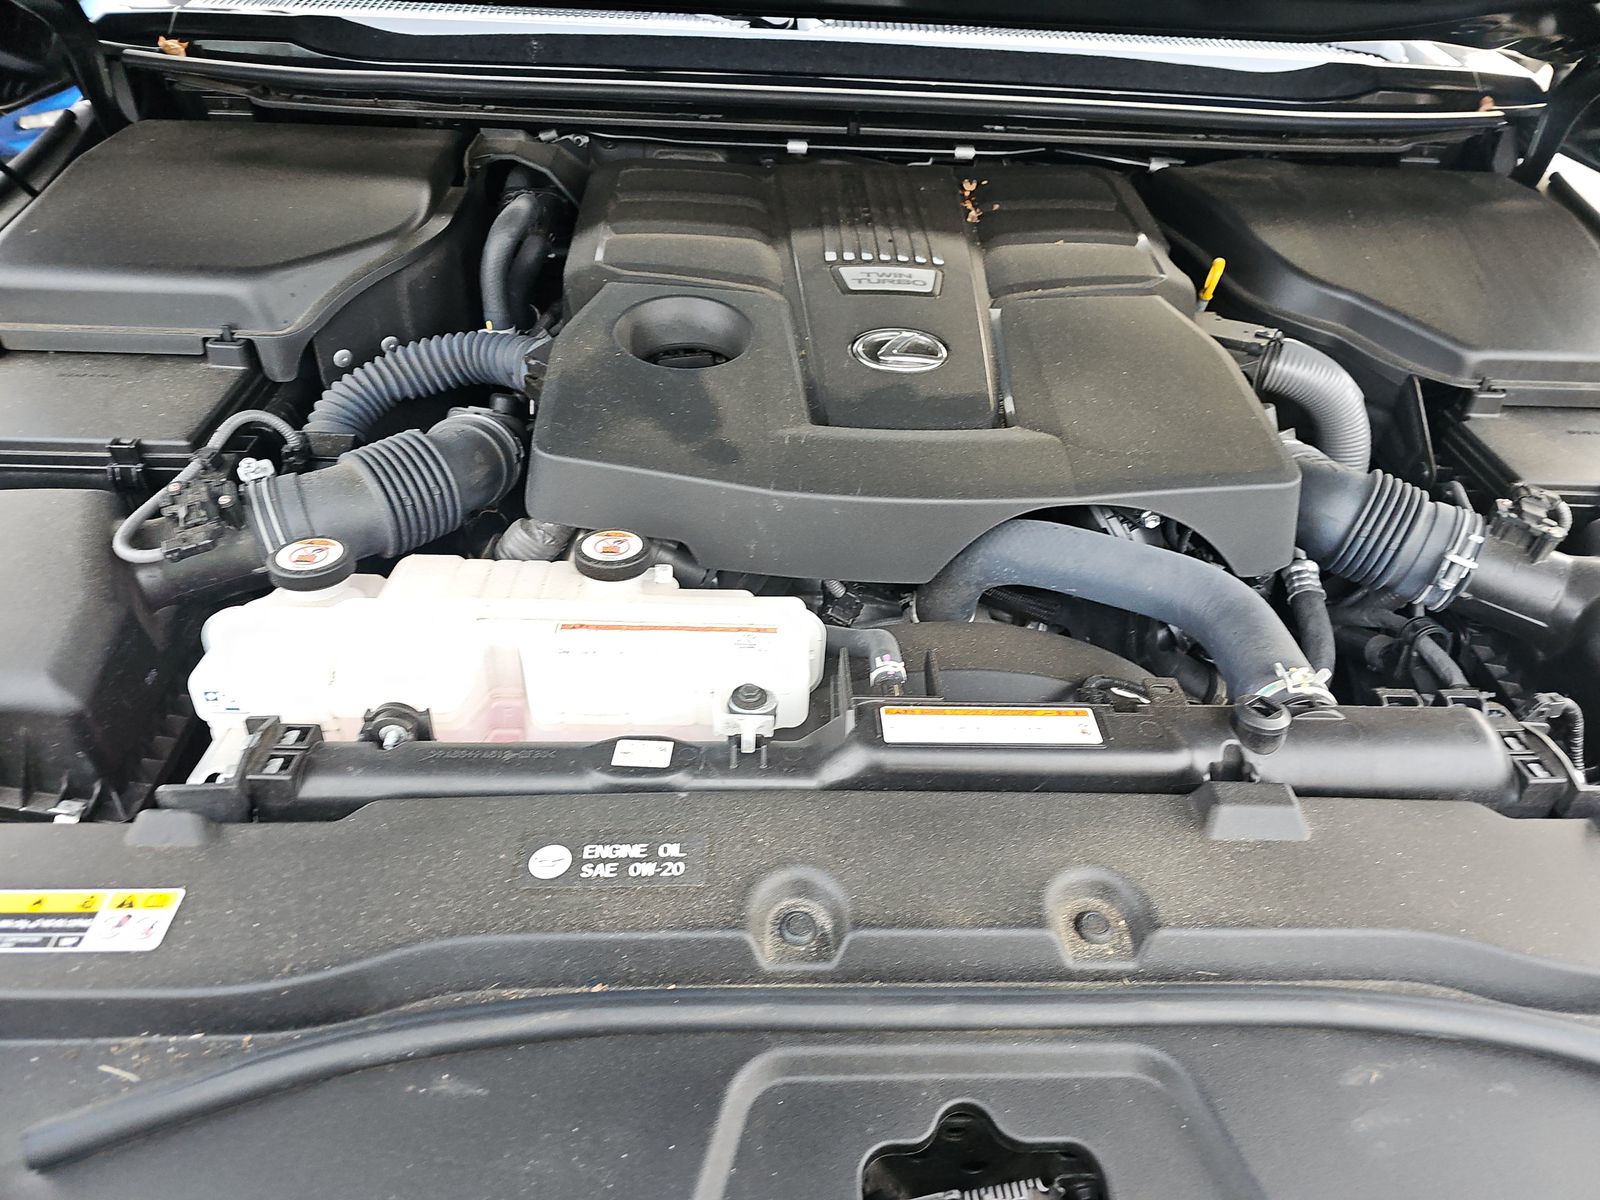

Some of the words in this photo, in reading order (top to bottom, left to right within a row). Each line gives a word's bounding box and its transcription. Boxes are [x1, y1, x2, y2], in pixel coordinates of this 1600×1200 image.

[859, 271, 913, 279] TWIN
[851, 278, 927, 287] TURBO
[582, 843, 649, 859] ENGINE
[657, 842, 688, 858] OIL
[579, 862, 620, 878] SAE
[628, 861, 686, 877] 0W-20
